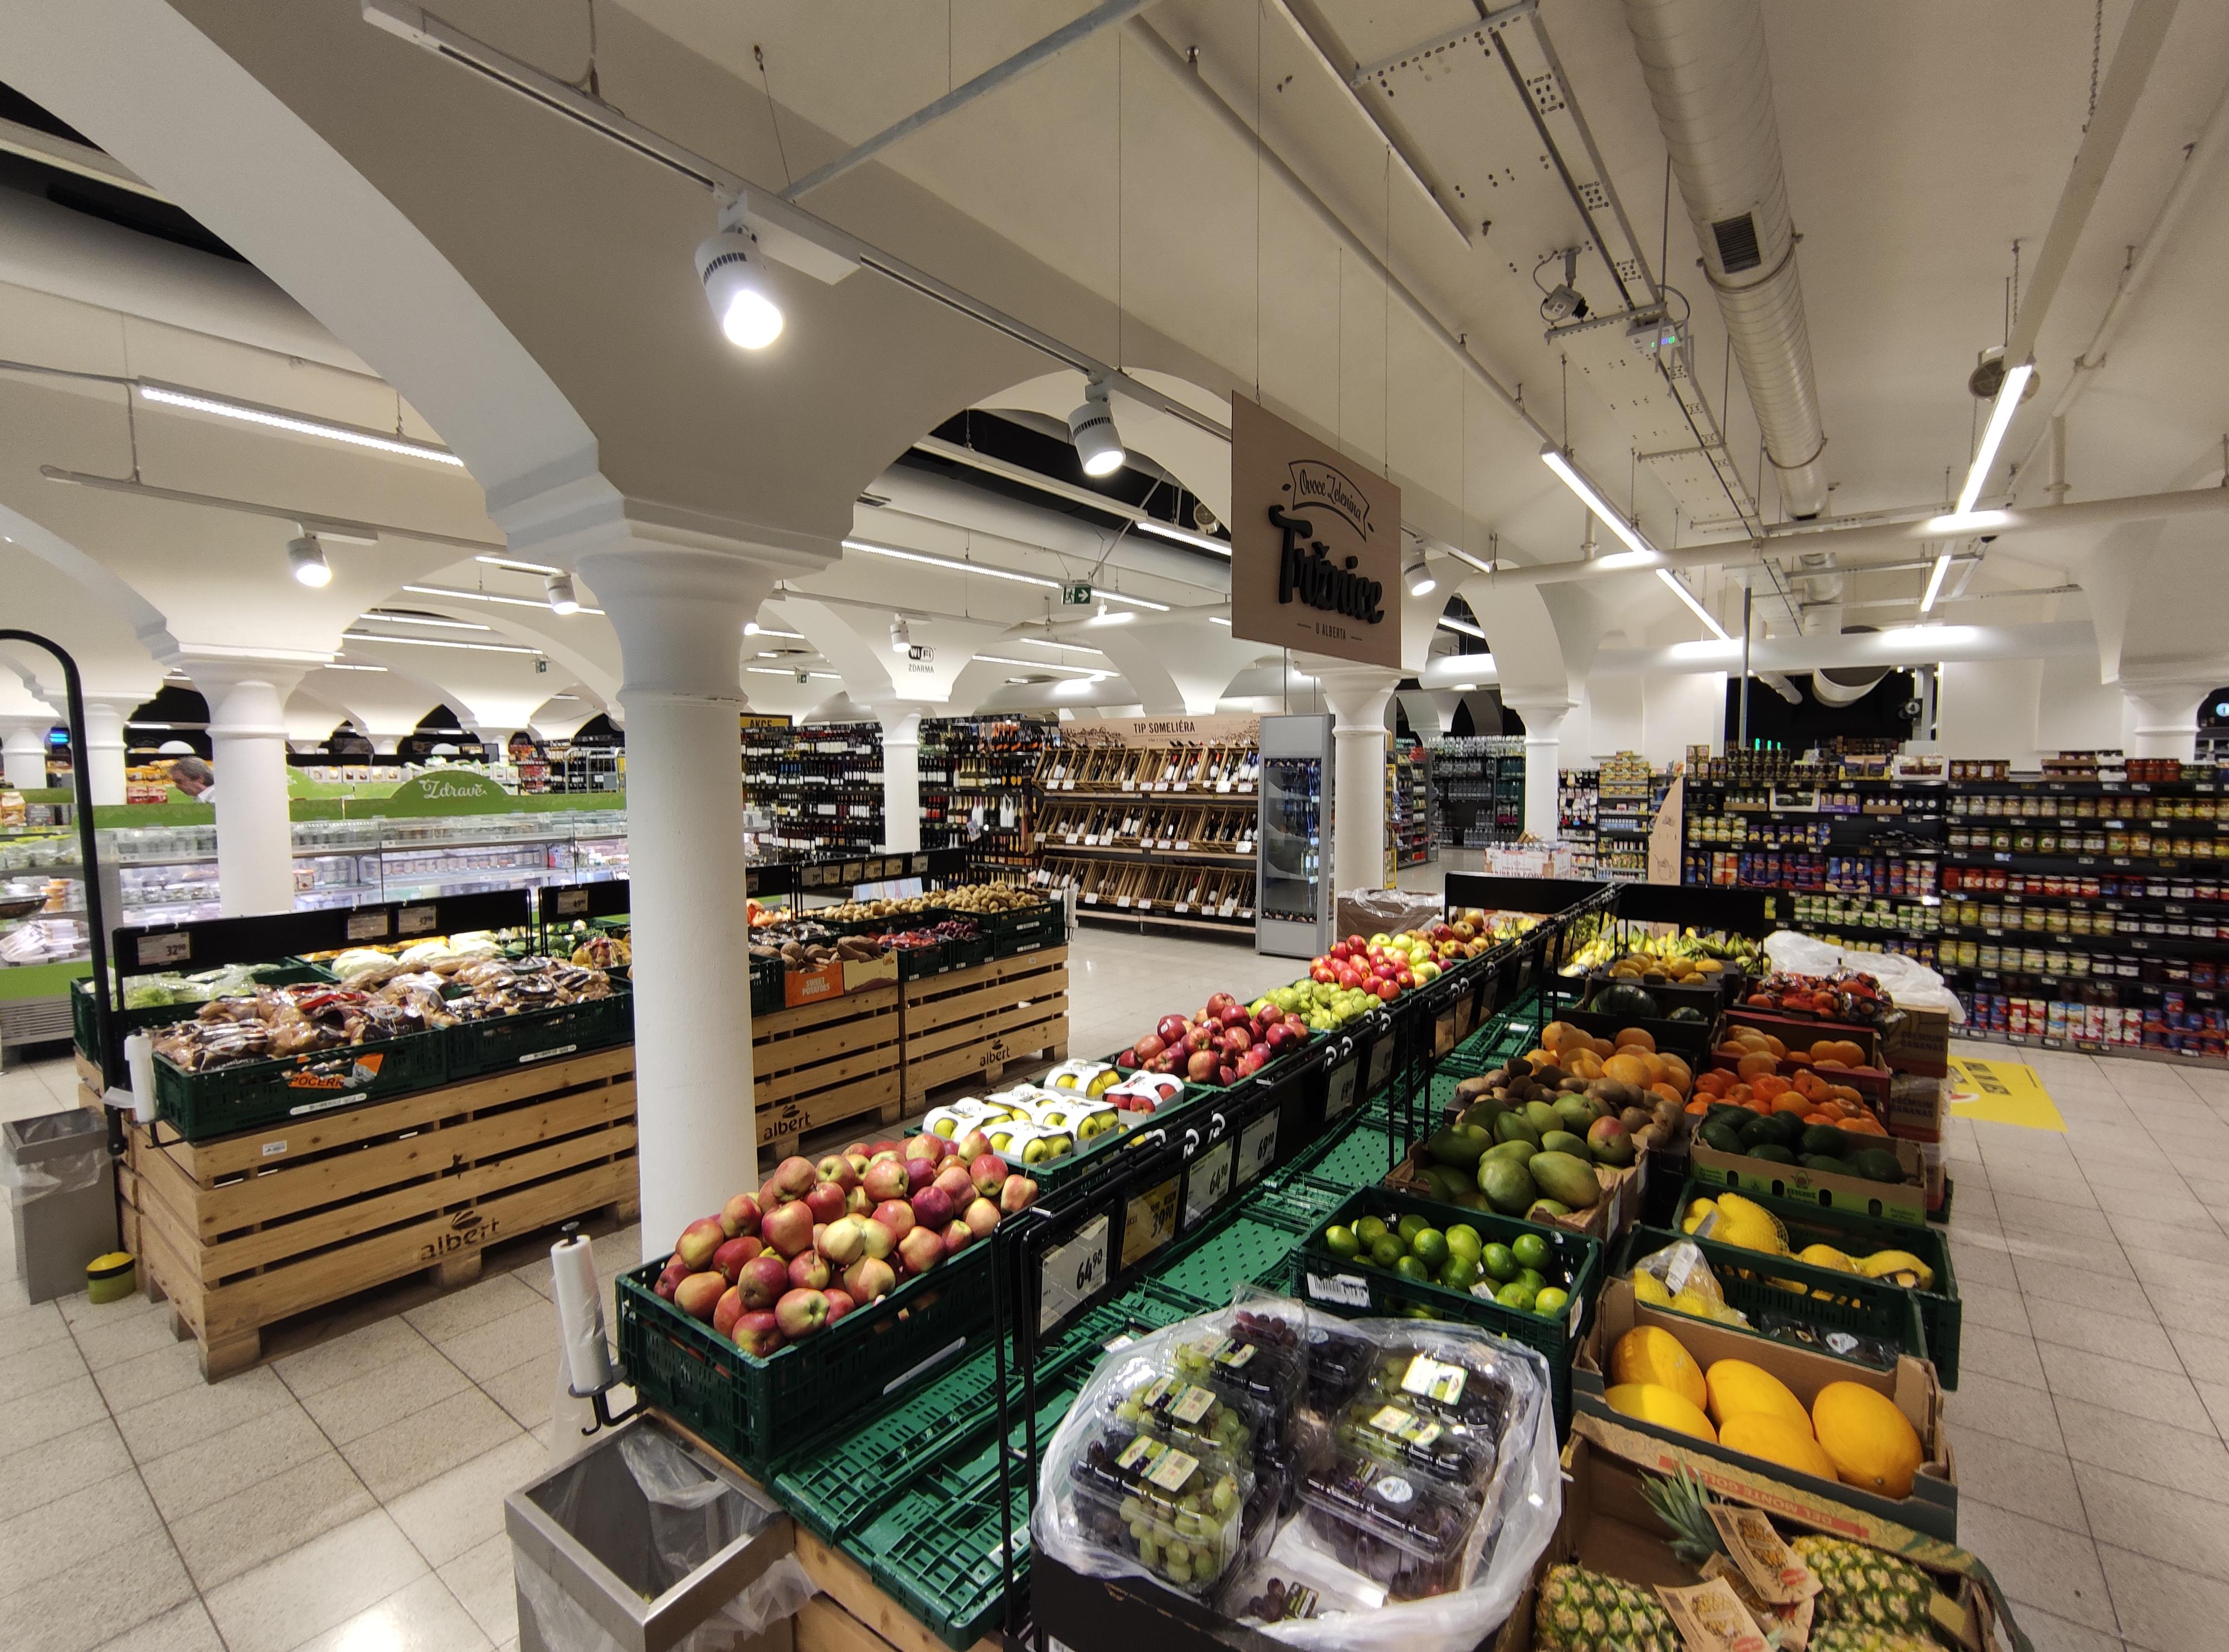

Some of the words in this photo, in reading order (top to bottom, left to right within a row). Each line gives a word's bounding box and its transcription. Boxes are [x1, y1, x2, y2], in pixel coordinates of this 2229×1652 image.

[1300, 469, 1326, 496] Ovoce
[1326, 474, 1361, 523] Zelenina
[1268, 504, 1385, 625] Tržnice
[1316, 622, 1320, 635] U
[1322, 625, 1346, 641] ALBERTA
[908, 663, 934, 673] ZDARMA
[1133, 723, 1146, 734] TIP
[1148, 719, 1195, 734] SOMELIÉRA
[802, 983, 830, 996] POTATOES
[806, 976, 825, 986] SWEET
[980, 1045, 1010, 1066] albert
[763, 1111, 811, 1141] albert
[421, 1217, 500, 1261] albert
[1743, 1487, 1798, 1512] MONTE
[1806, 1510, 1832, 1526] DEL
